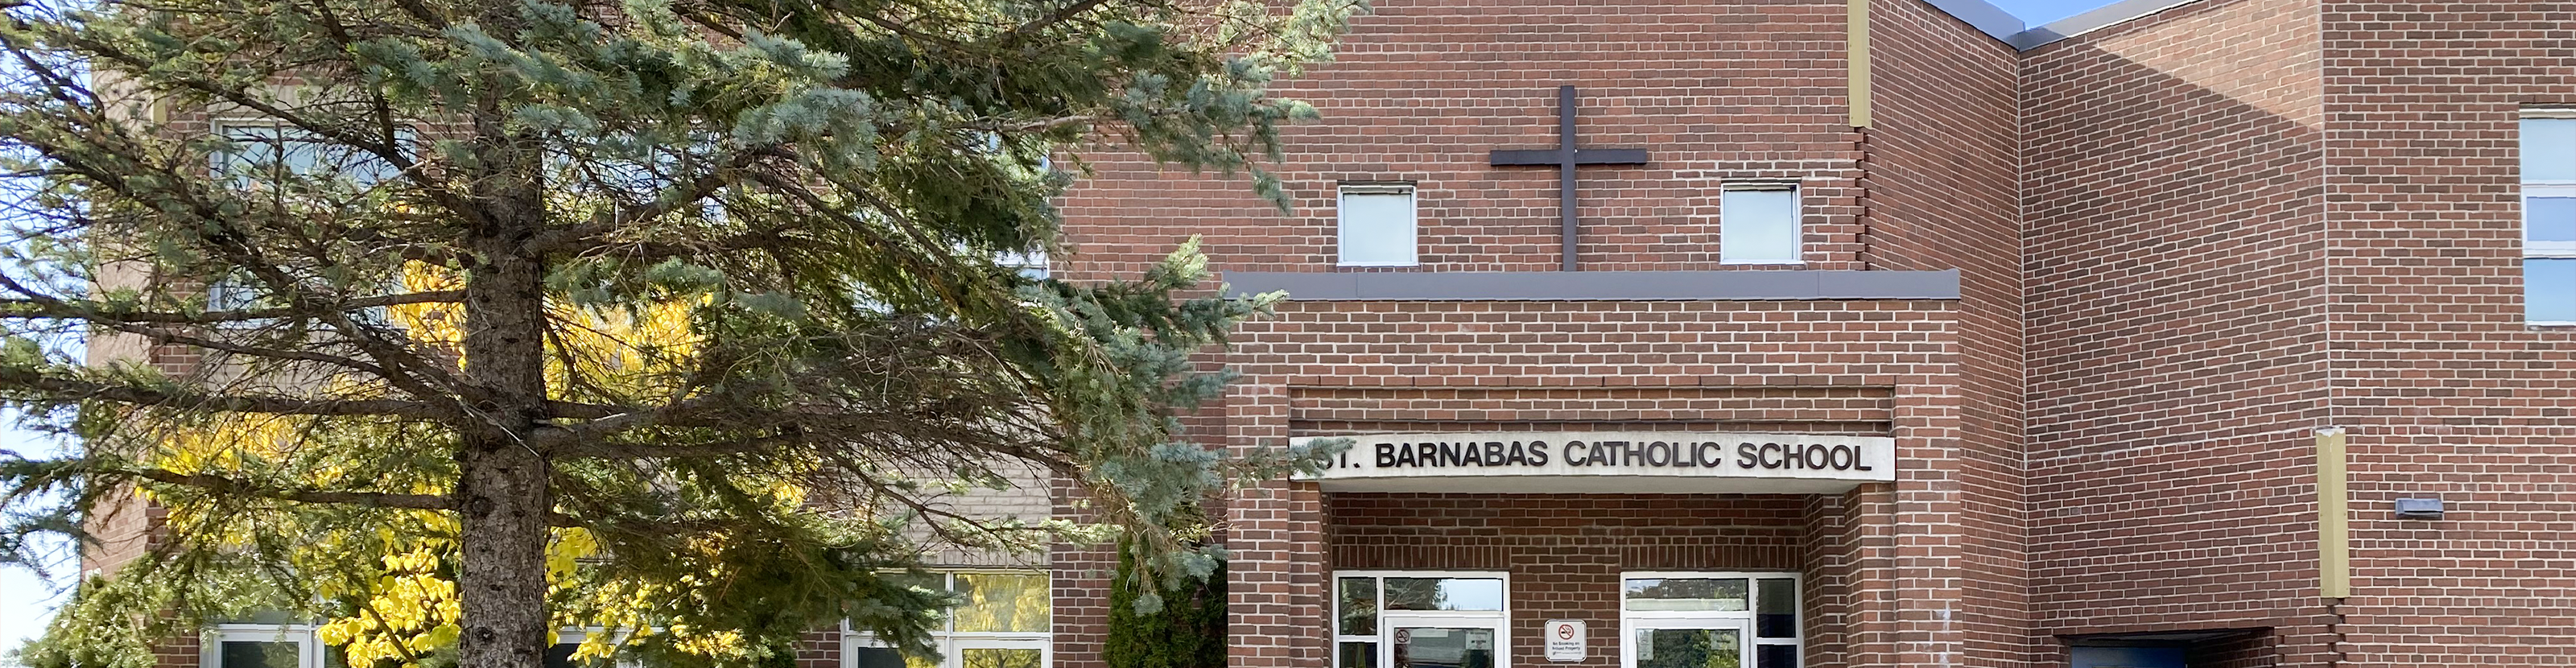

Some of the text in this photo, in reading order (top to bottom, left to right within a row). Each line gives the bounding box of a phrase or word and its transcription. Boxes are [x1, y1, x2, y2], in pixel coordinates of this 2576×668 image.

[1375, 440, 1549, 468] BARNABAS
[1563, 440, 1722, 468] CATHOLIC
[1737, 443, 1872, 471] SCHOOL
